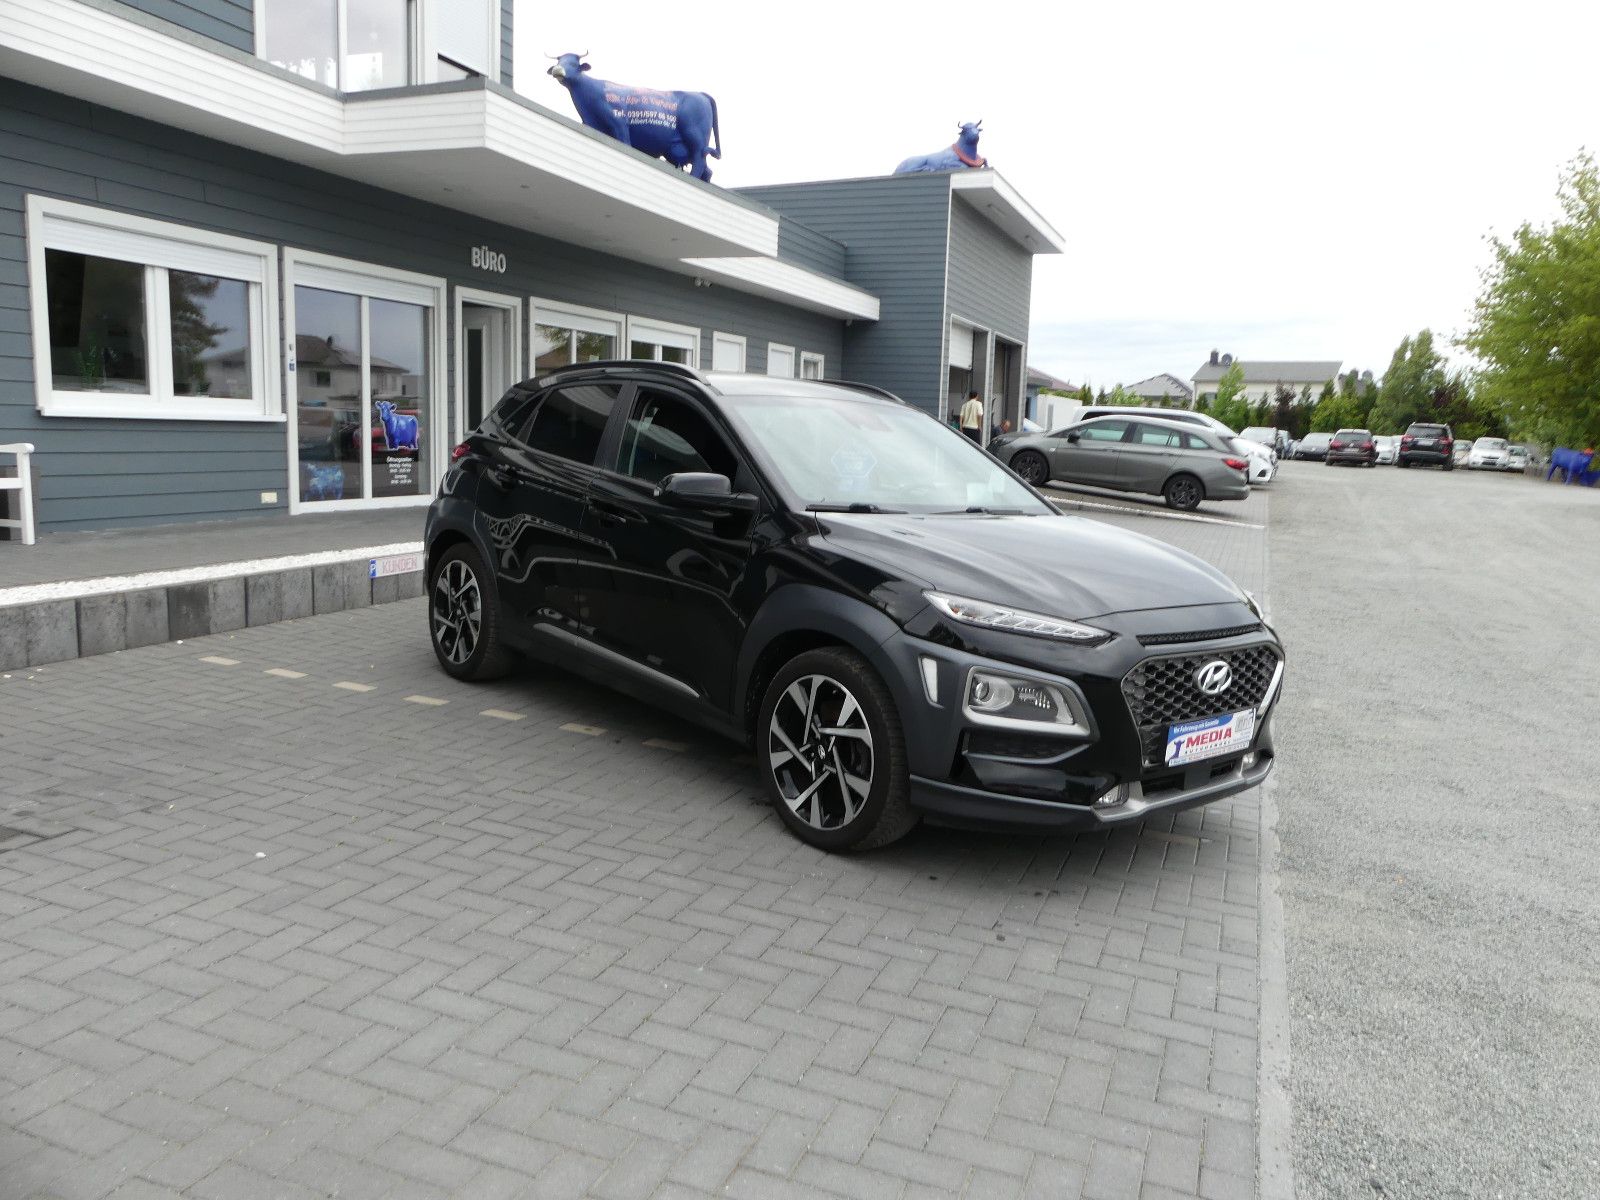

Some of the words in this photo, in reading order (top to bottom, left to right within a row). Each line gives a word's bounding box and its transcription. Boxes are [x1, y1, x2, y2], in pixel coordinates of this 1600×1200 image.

[612, 109, 626, 118] Tel.
[471, 245, 507, 273] BÜRO
[1185, 727, 1232, 749] MEDIA
